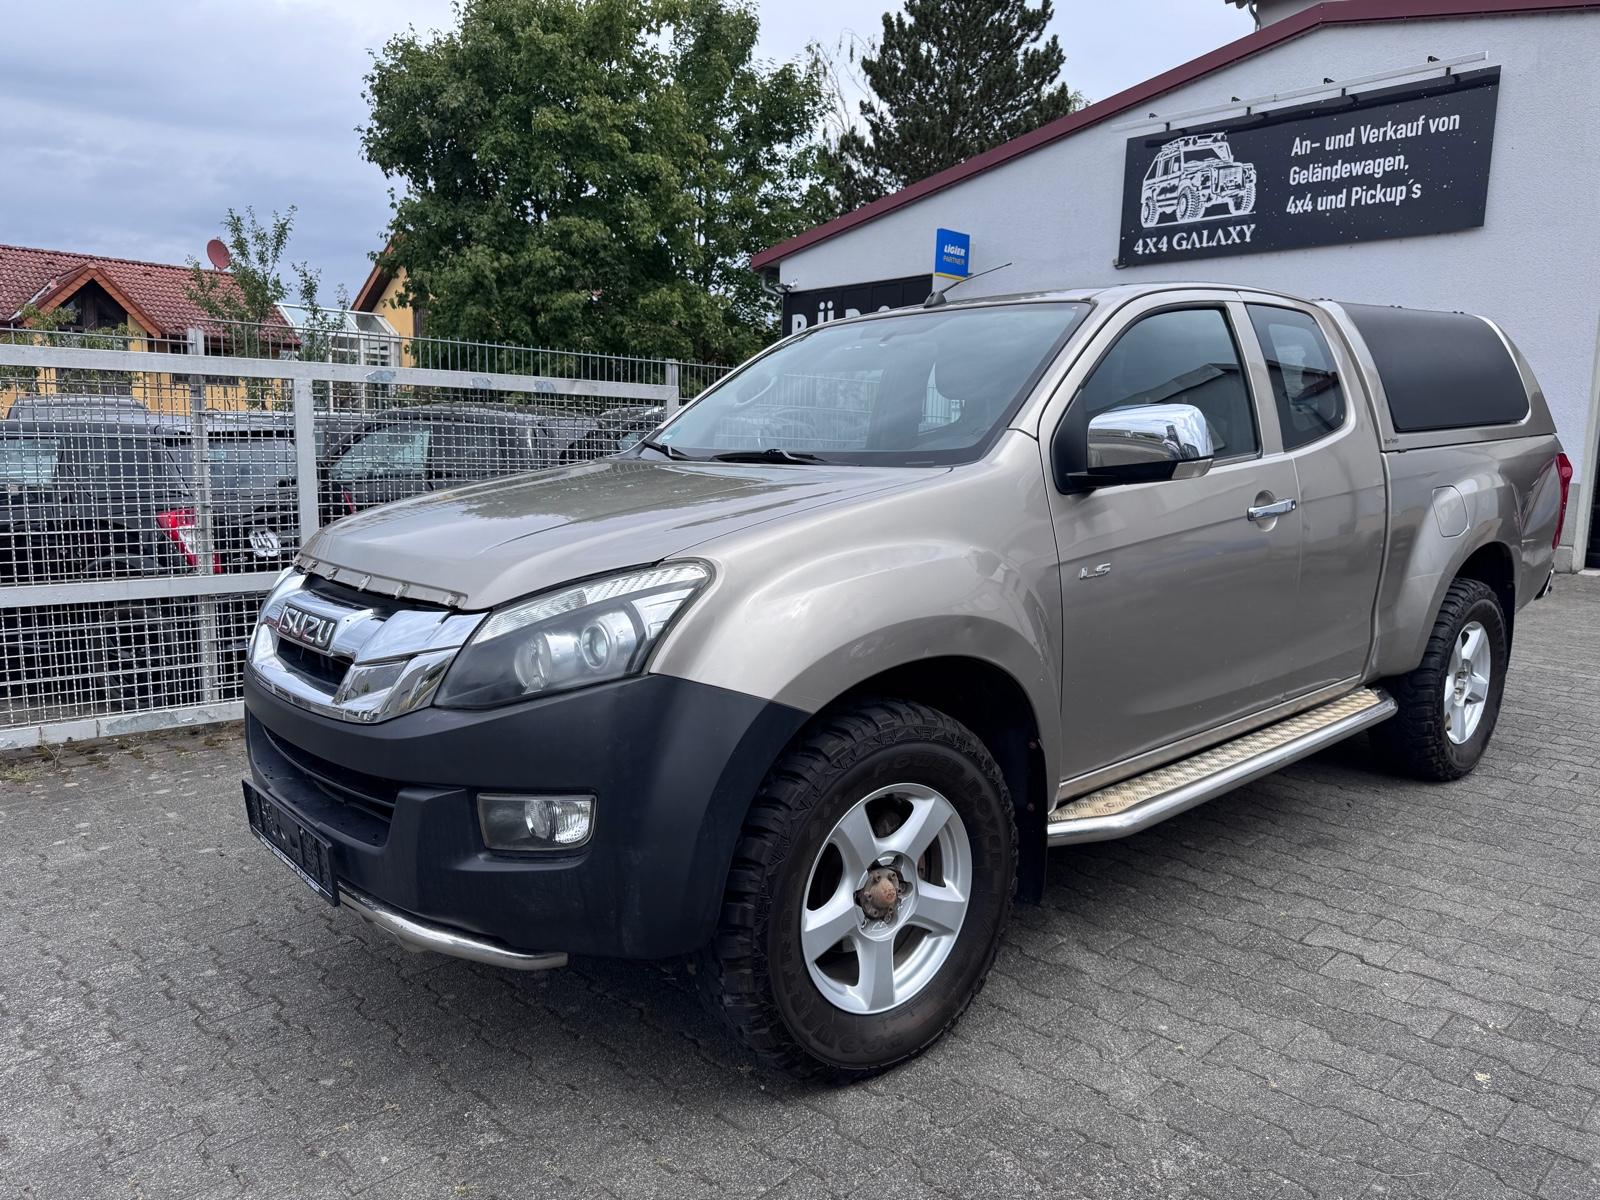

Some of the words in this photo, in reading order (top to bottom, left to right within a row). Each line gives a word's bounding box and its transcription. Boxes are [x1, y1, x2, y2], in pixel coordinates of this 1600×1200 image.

[1291, 137, 1321, 157] An-
[1325, 127, 1356, 151] und
[1360, 115, 1426, 145] Verkauf
[1429, 114, 1461, 134] von
[1289, 154, 1410, 186] Geländewagen,
[1286, 193, 1314, 215] 4x4
[1317, 188, 1347, 211] und
[1133, 235, 1169, 255] 4X4
[1172, 223, 1257, 251] GALAXY
[1078, 563, 1111, 580] LS
[278, 605, 336, 648] ISUZU
